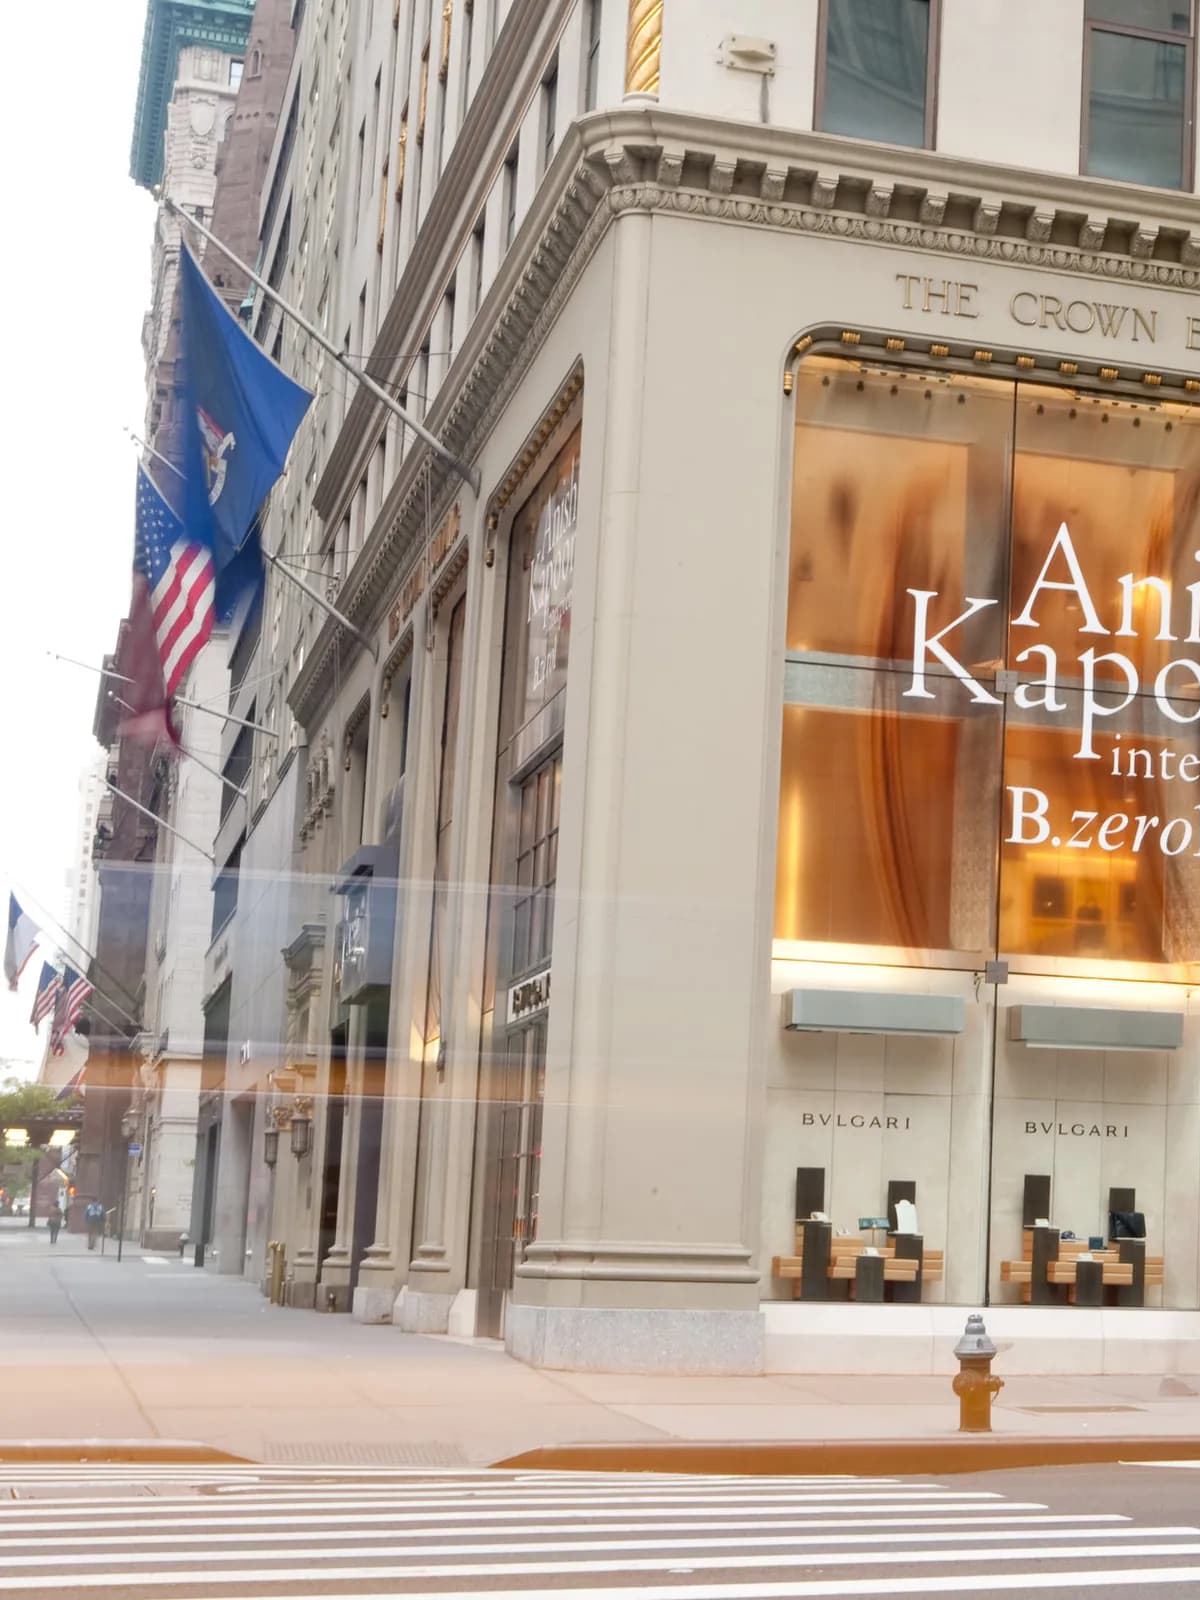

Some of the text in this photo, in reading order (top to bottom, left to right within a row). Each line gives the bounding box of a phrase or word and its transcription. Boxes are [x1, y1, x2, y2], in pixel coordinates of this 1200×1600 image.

[895, 273, 980, 319] THE
[1009, 291, 1158, 344] CROWN
[802, 1113, 910, 1129] BVLGARI
[1025, 1122, 1128, 1137] BVLGARI
